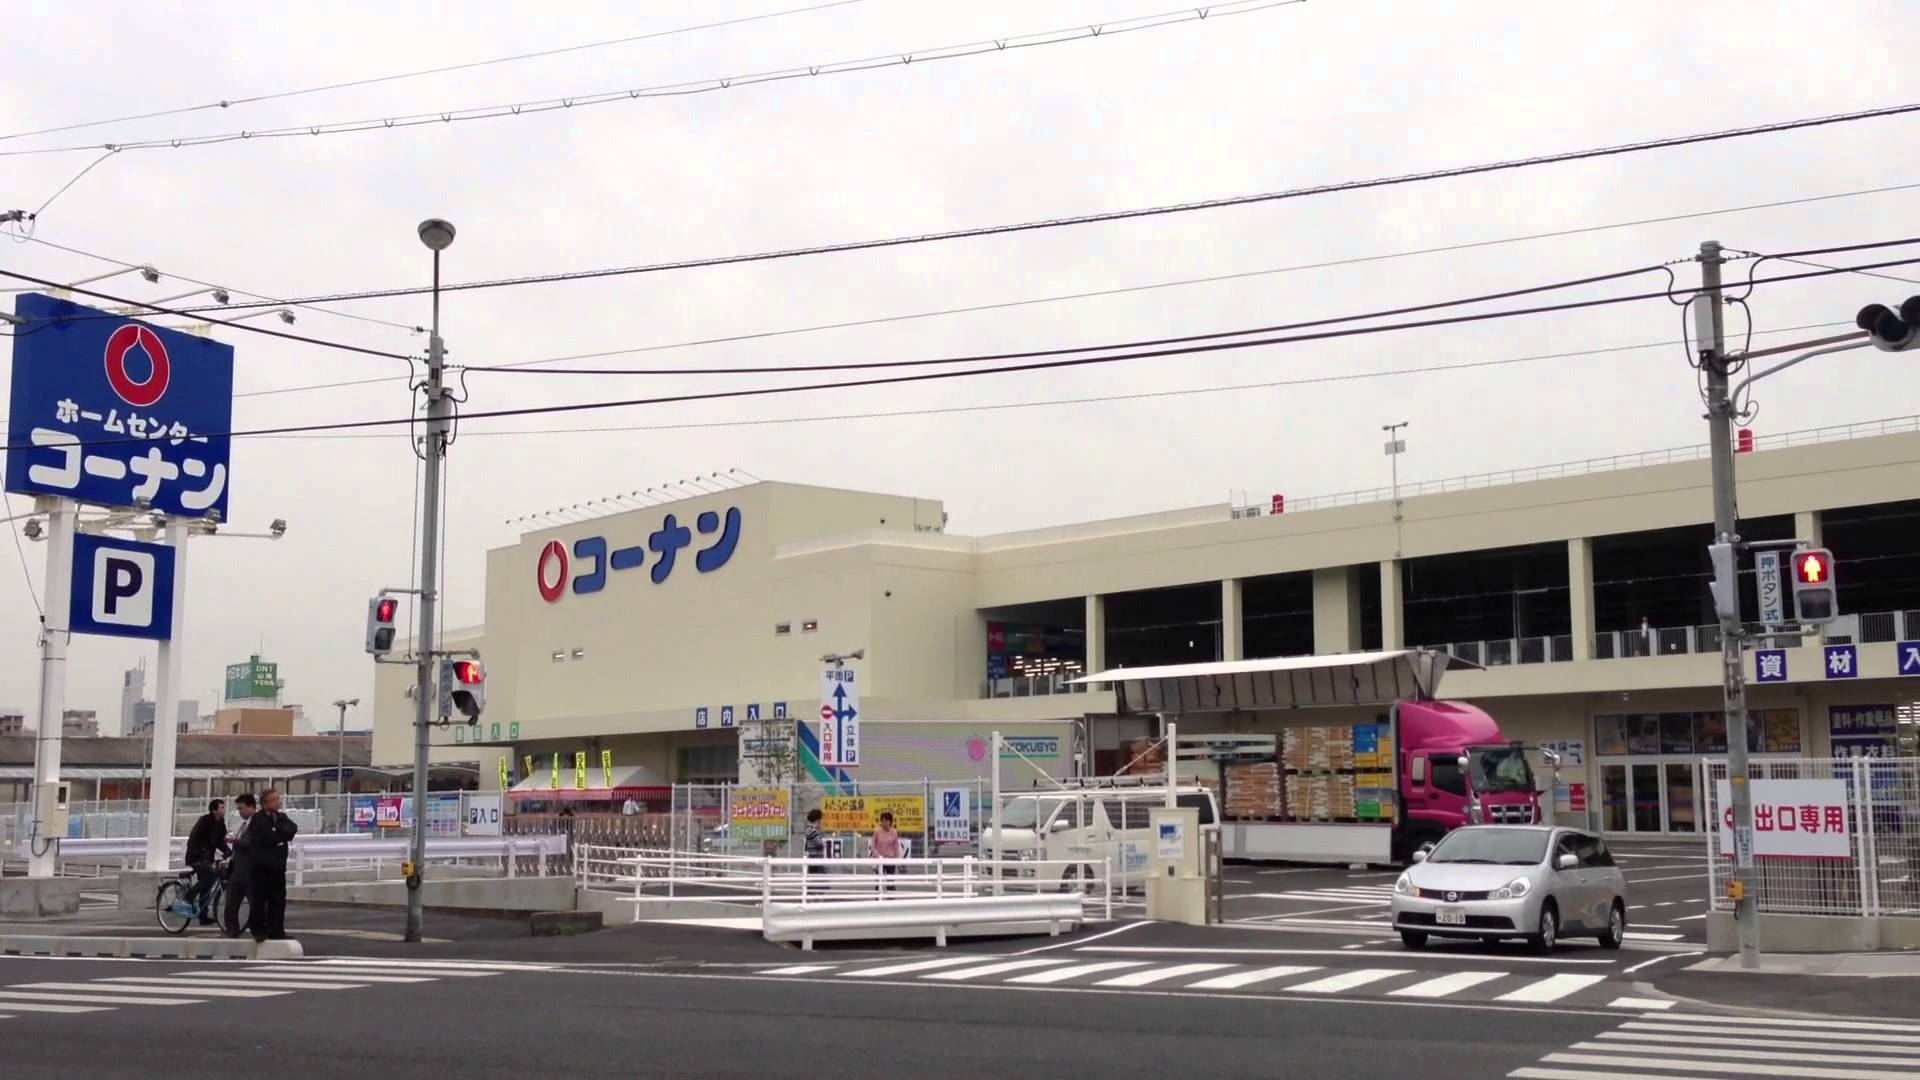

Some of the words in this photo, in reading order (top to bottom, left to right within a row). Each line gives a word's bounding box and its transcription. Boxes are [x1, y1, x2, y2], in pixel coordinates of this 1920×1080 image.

[56, 399, 208, 444] ホームセンター
[28, 427, 226, 510] コーナン
[572, 506, 741, 595] コーナン
[103, 557, 143, 614] P
[1761, 556, 1778, 620] 押ボタン式
[696, 705, 787, 727] 店内入口
[1755, 803, 1844, 833] 出口専用
